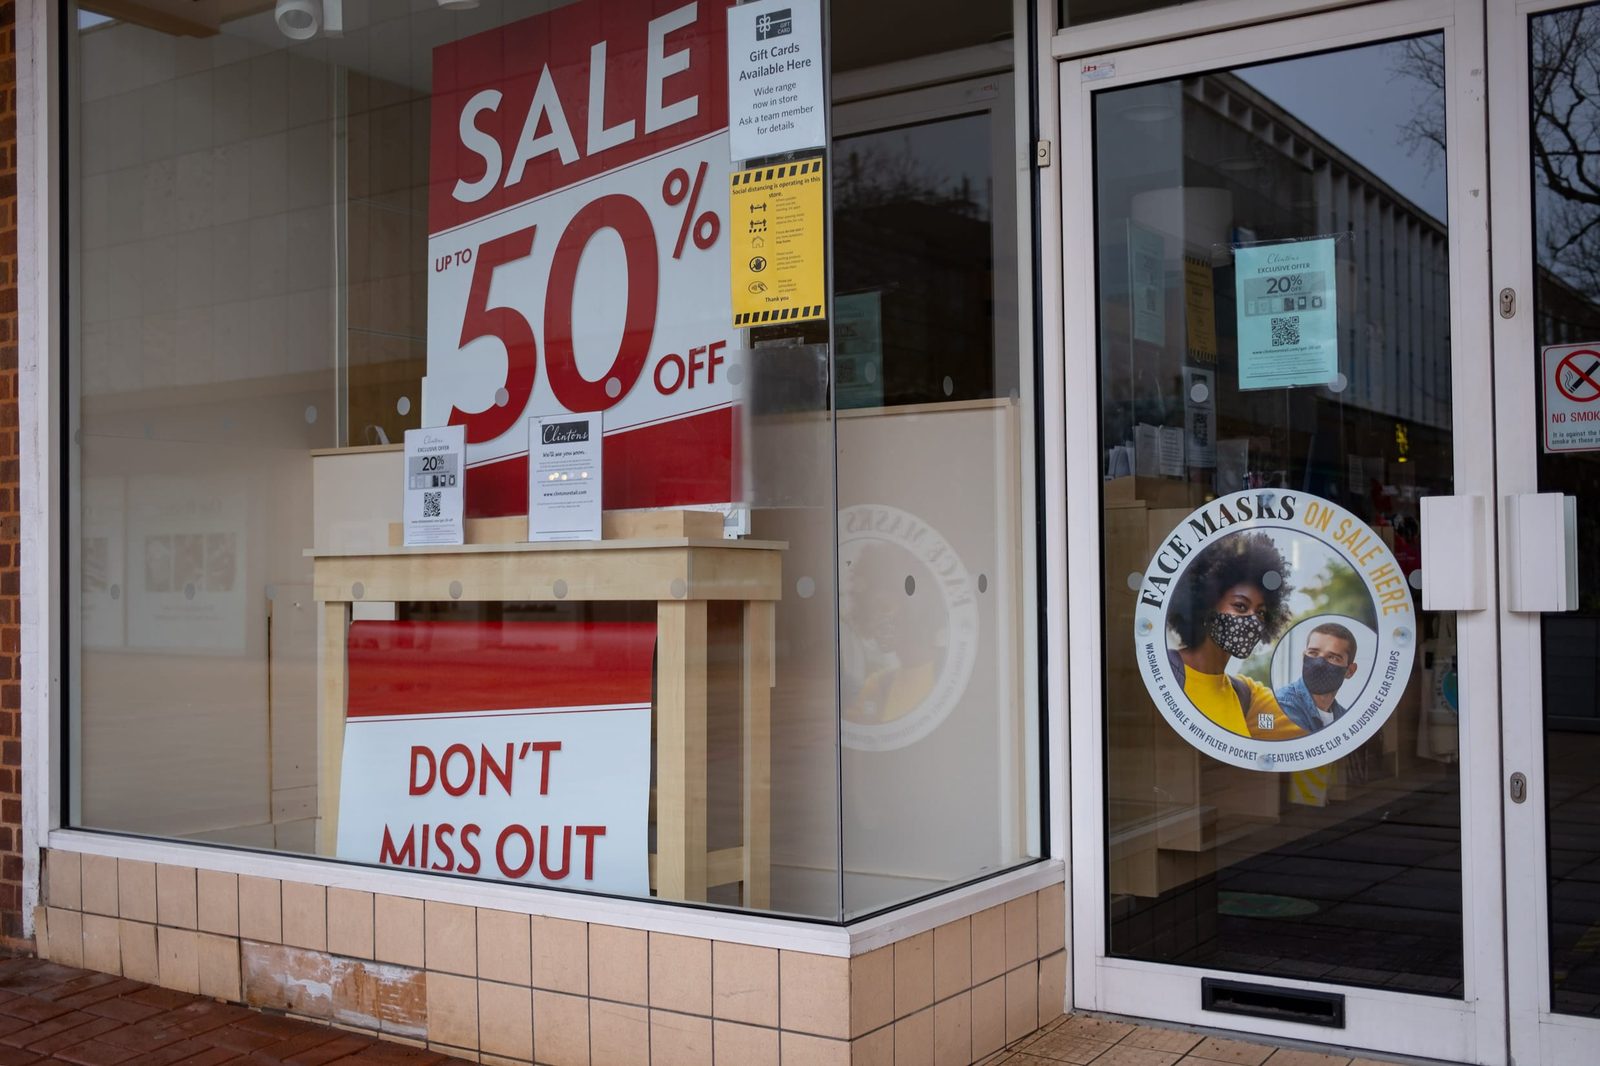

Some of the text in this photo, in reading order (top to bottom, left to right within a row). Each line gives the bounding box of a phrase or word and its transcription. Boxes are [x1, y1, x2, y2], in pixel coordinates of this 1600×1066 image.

[750, 43, 800, 62] Gift Cards
[739, 58, 811, 81] Available Here
[754, 82, 796, 96] Wide range
[452, 1, 699, 203] SALE
[752, 94, 798, 109] now in store
[739, 115, 752, 126] Ask
[760, 112, 780, 122] team
[781, 105, 814, 117] member
[757, 121, 794, 135] for details
[733, 187, 746, 195] Social
[748, 183, 773, 193] distancing
[779, 179, 803, 189] operating
[435, 248, 472, 272] UP TO
[1258, 265, 1289, 274] EXCLUSIVE
[654, 340, 726, 396] OFF
[1552, 413, 1566, 423] NO
[544, 424, 588, 443] Clintons
[1140, 494, 1409, 616] FACE MASKS ON SALE HERE
[1385, 650, 1400, 681] STRAPS
[1378, 680, 1393, 697] EAR
[1145, 642, 1162, 683] WASHABLE
[1162, 691, 1190, 726] REUSABLE
[1188, 722, 1206, 740] WITH
[1205, 734, 1228, 752] FILTER
[1229, 746, 1258, 761] POCKET
[1348, 695, 1384, 736] ADJUSTABLE
[1325, 735, 1342, 750] CLIP
[1342, 732, 1350, 741] &
[1305, 744, 1326, 759] NOSE
[409, 740, 562, 797] DON'T
[379, 823, 606, 880] MISS OUT
